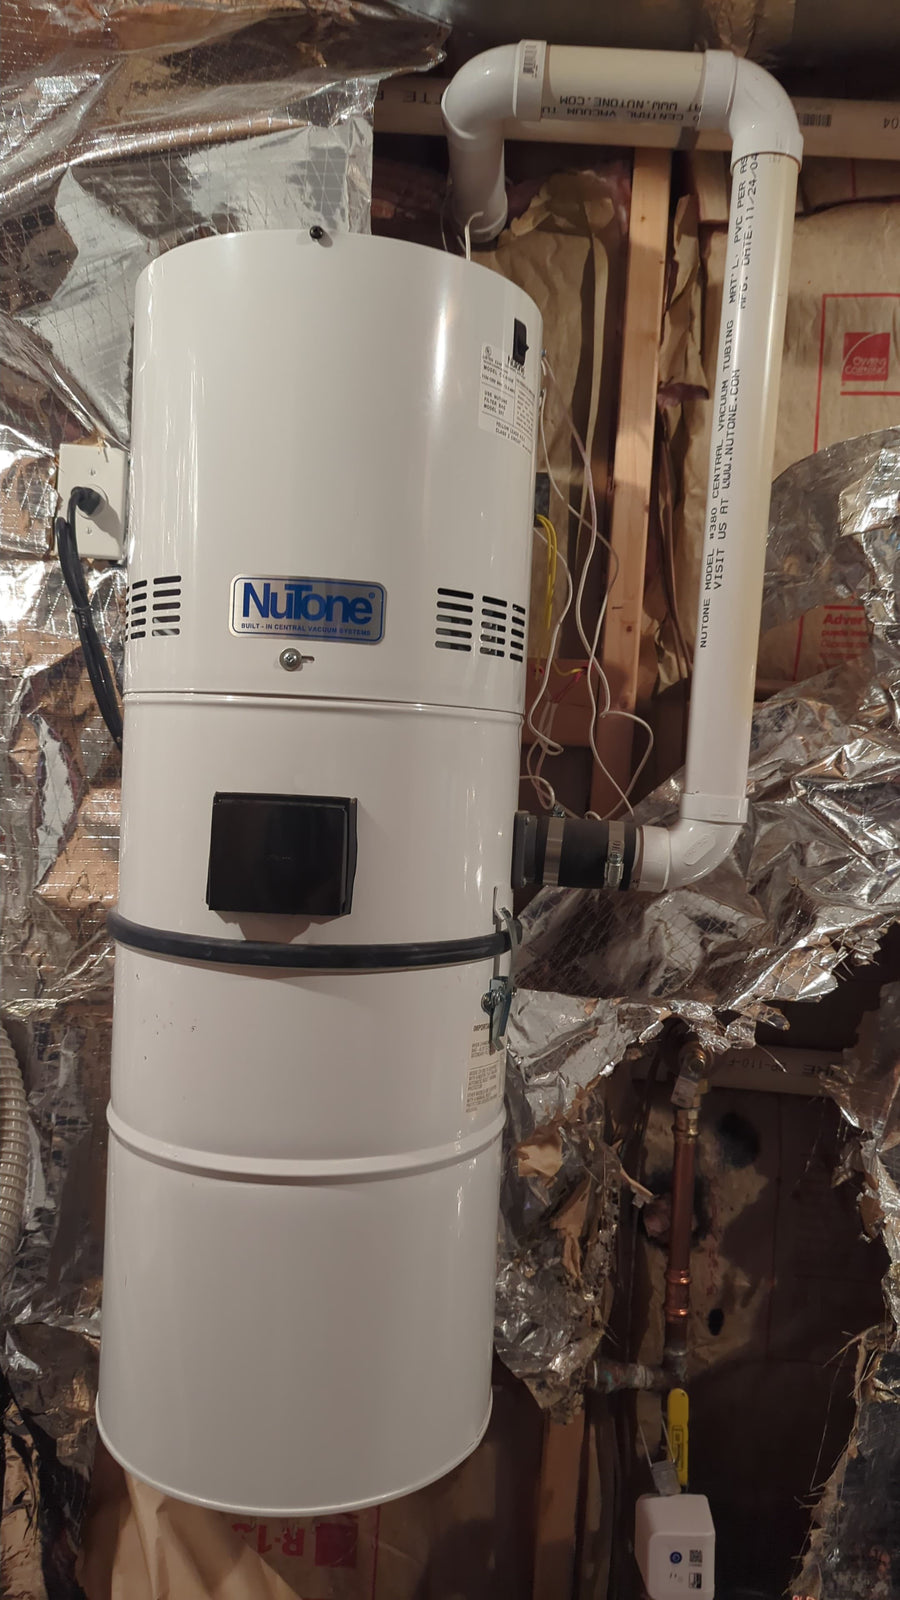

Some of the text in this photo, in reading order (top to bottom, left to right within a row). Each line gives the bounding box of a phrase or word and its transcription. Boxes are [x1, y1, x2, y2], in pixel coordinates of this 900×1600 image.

[559, 95, 678, 111] WWW.NUTONE.COM
[567, 107, 617, 118] VACUUM
[625, 110, 684, 121] CENTRAL
[736, 180, 747, 208] PER
[734, 216, 744, 243] PVC
[738, 275, 750, 310] MFG.
[723, 319, 734, 376] TUBING
[718, 379, 729, 431] VACUUM
[723, 367, 741, 490] WWW.NUTONE.COM
[712, 439, 724, 499] CENTRAL
[719, 497, 728, 515] AT
[709, 507, 717, 540] #380
[718, 521, 727, 540] US
[705, 548, 715, 590] MODEL
[713, 548, 725, 590] VISIT
[242, 582, 371, 624] NuTone
[274, 624, 306, 632] CENTRAL
[307, 625, 337, 633] VACUUM
[339, 628, 372, 636] SYSTEMS
[699, 597, 711, 649] NUTONE
